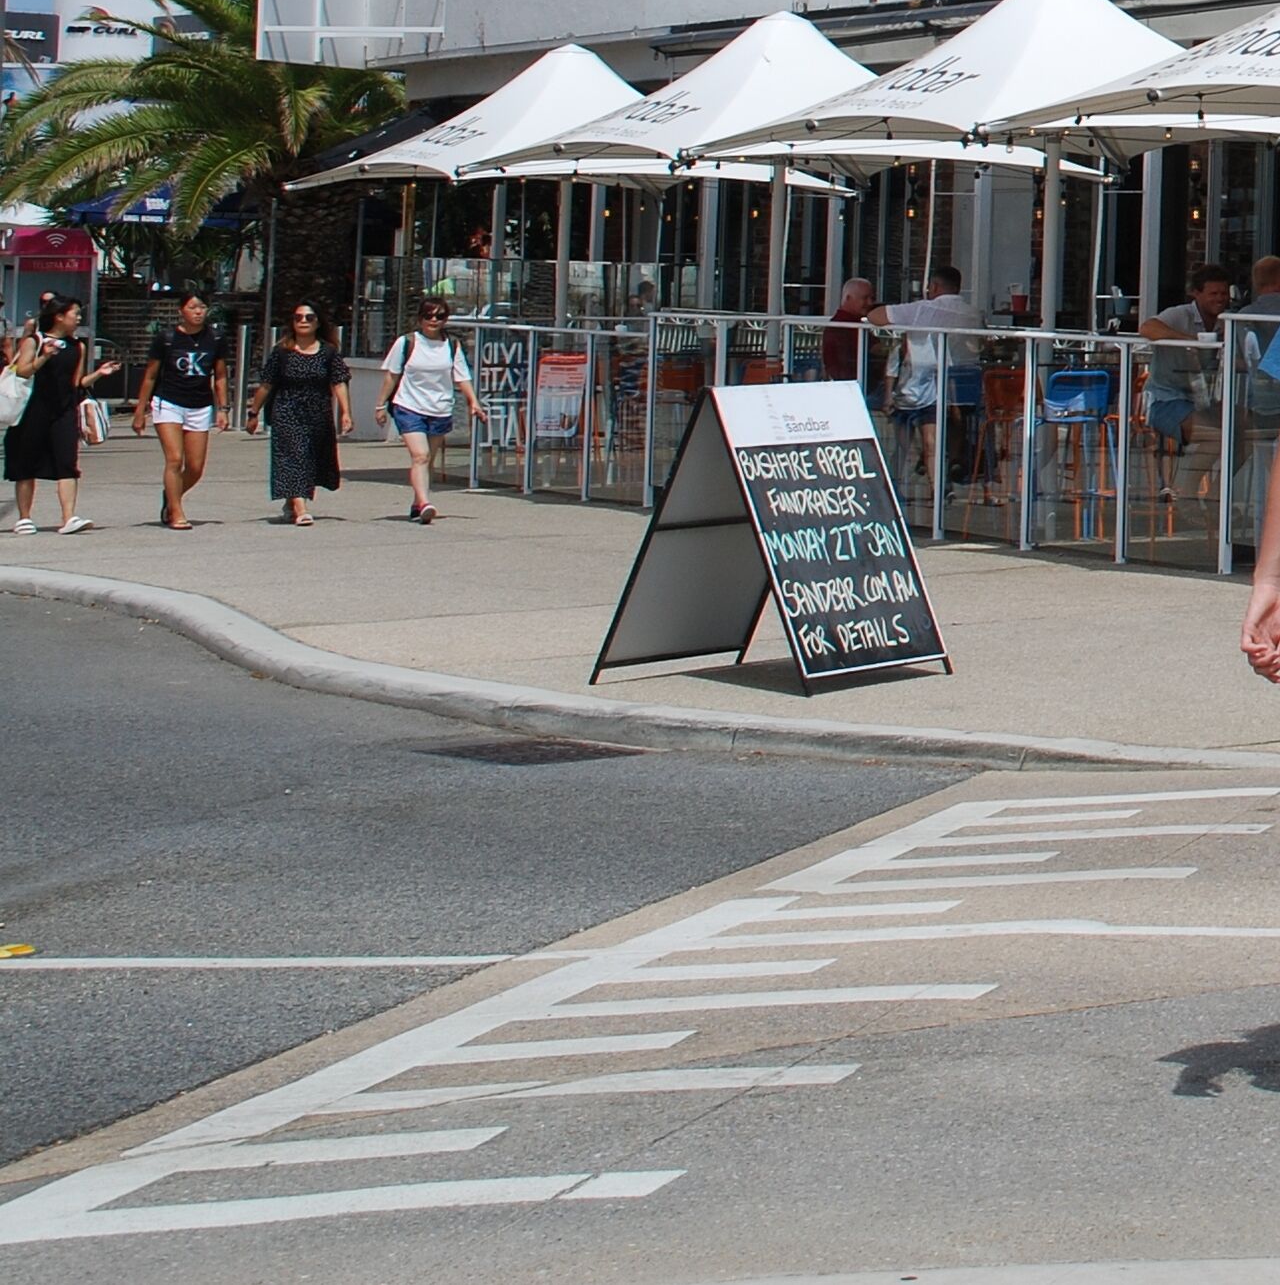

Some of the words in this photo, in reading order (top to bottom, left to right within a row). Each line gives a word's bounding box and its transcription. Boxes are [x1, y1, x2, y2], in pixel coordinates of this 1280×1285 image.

[92, 26, 139, 37] CURL
[785, 417, 831, 434] sandbar
[740, 449, 818, 482] BUSHFIRE
[816, 445, 877, 481] APPEAL
[763, 525, 832, 566] MONDAY
[862, 520, 906, 558] JAN
[797, 623, 838, 659] FOR
[836, 613, 911, 654] DETAILS
